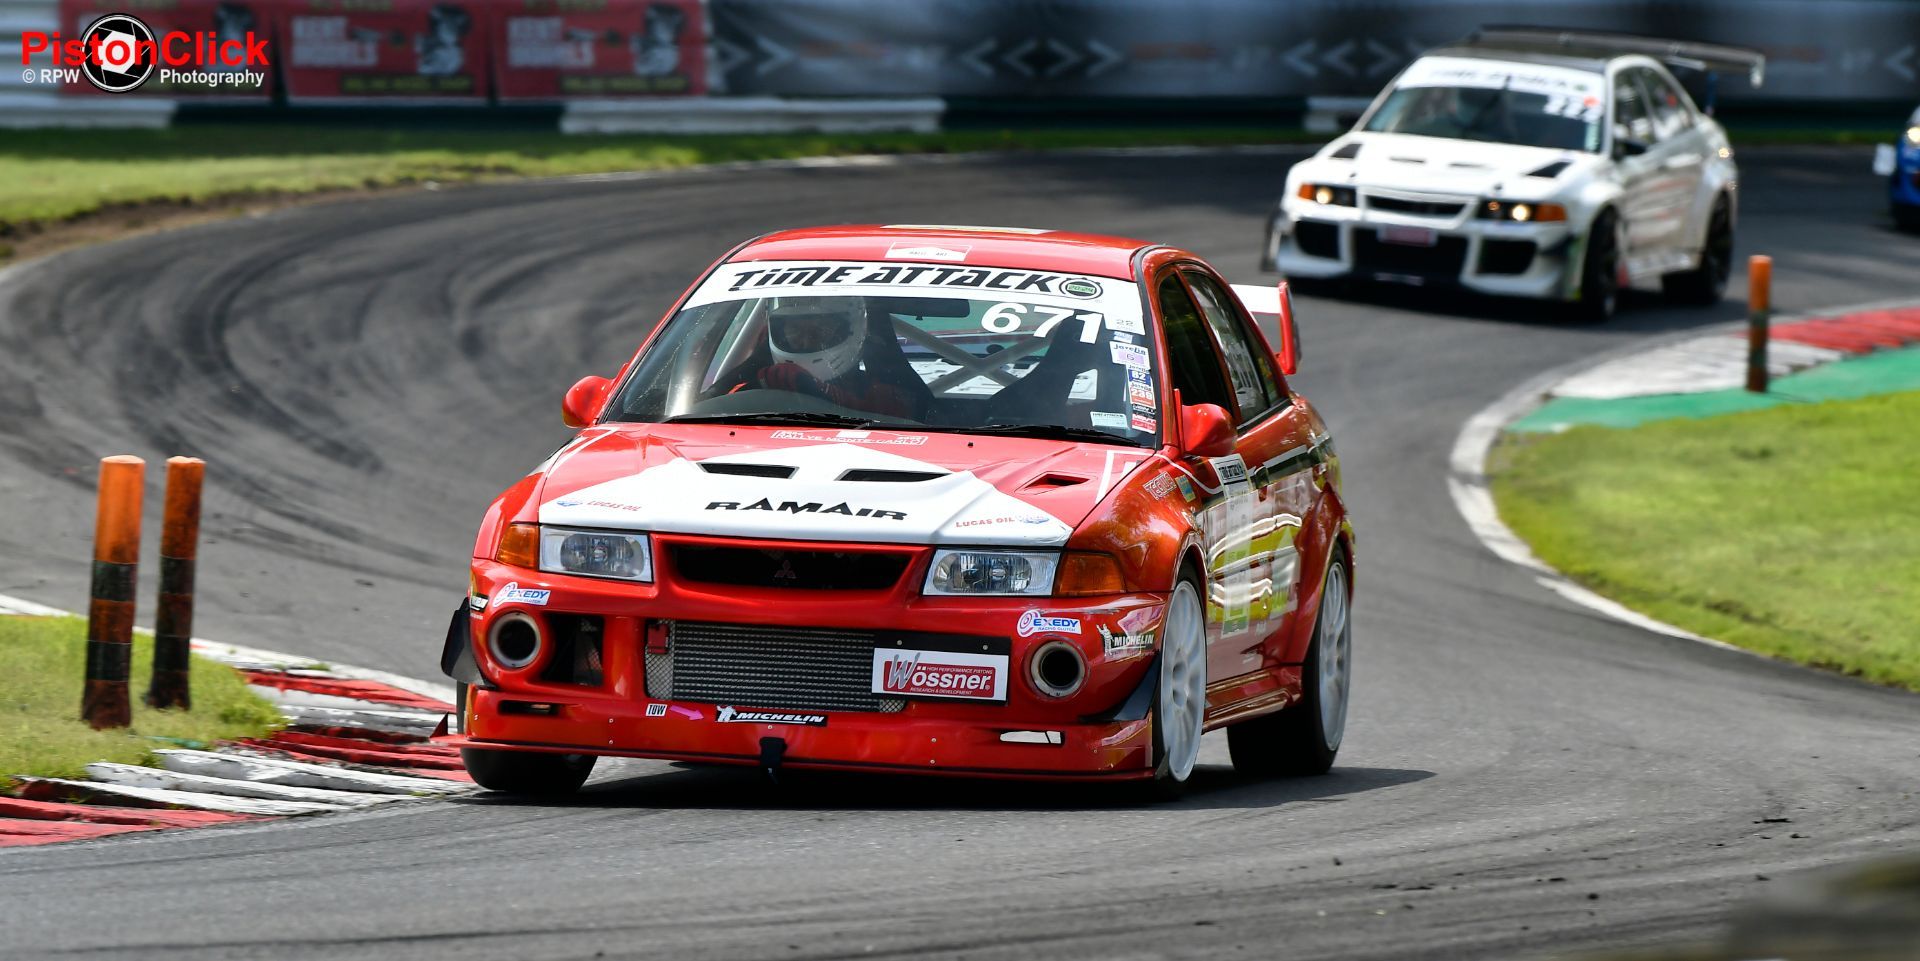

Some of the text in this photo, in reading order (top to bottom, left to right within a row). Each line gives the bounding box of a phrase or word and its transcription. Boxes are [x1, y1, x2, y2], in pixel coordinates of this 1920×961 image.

[728, 266, 1061, 293] TIME ATTACK
[981, 302, 1104, 345] 671
[705, 497, 908, 520] RAMAIR
[955, 518, 993, 528] LUCAS
[507, 590, 549, 599] EXEDY
[1033, 618, 1079, 628] EXEDY
[1113, 633, 1155, 647] MICHELIN
[648, 704, 666, 716] TOW
[736, 712, 825, 723] MICHELIN
